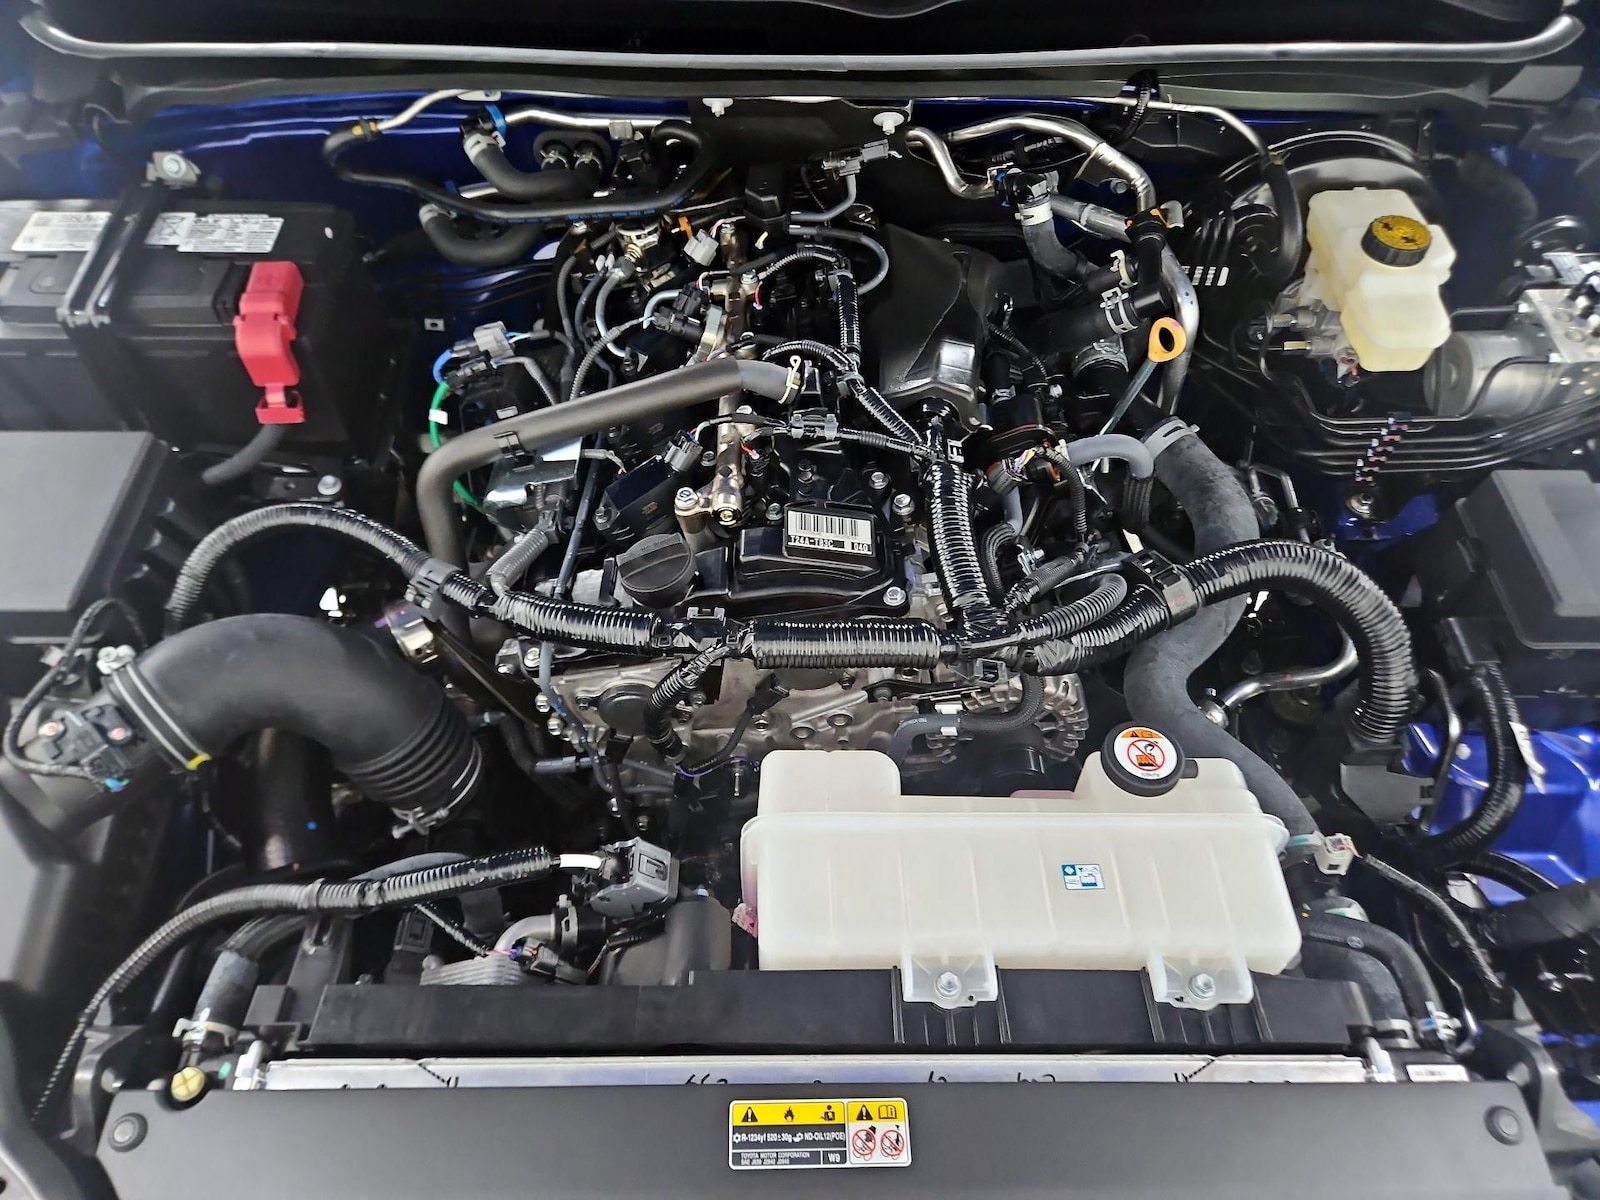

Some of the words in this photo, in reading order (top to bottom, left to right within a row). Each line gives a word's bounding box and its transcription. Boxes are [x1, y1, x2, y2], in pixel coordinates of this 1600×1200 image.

[853, 543, 868, 552] 040
[741, 1132, 766, 1143] R-1234yf
[828, 1153, 841, 1163] W9
